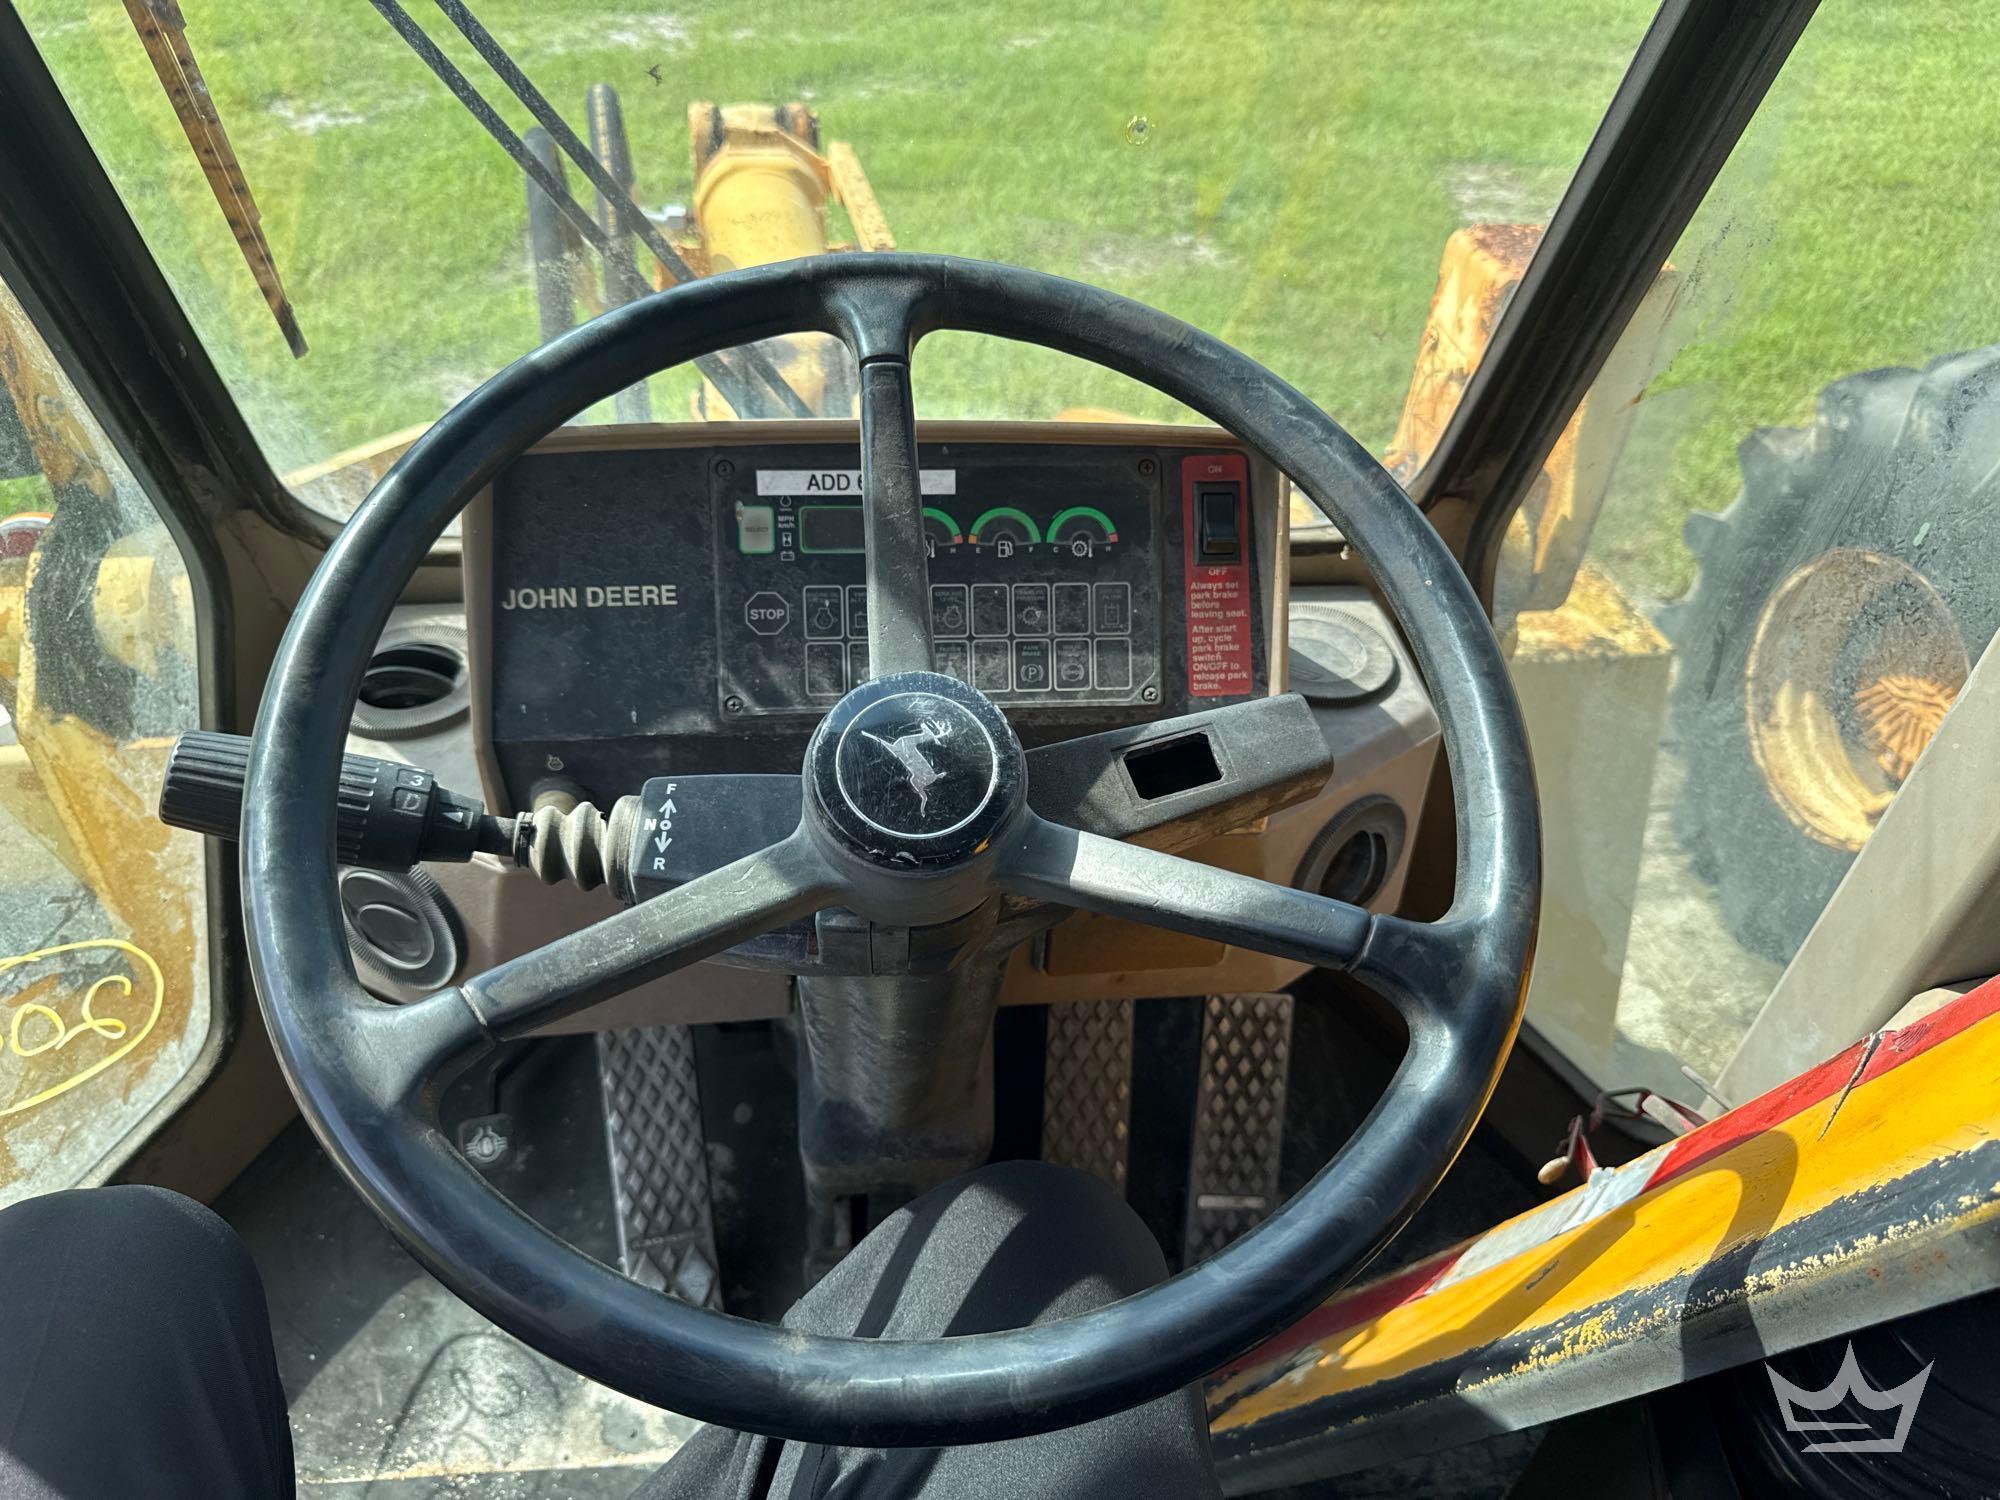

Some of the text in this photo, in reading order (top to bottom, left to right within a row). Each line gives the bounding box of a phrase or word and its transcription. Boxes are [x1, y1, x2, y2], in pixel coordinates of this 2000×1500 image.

[1208, 465, 1222, 474] ON
[807, 473, 850, 491] ADD
[1208, 567, 1228, 576] OFF
[1191, 581, 1239, 590] Always set
[502, 585, 678, 610] JOHN DEERE
[1191, 590, 1239, 601] park brake
[1191, 600, 1220, 609] before
[750, 608, 785, 620] STOP
[1191, 609, 1247, 620] leaving seat.
[1192, 625, 1237, 633] After start
[1208, 634, 1232, 645] cycle
[1192, 643, 1240, 653] park brake
[1192, 652, 1222, 662] switch
[1193, 662, 1240, 671] ON/OFF to
[1193, 671, 1248, 681] release park
[1193, 682, 1221, 691] brake.
[410, 775, 425, 786] 3
[666, 783, 678, 795] F
[643, 818, 657, 831] N
[653, 857, 666, 870] R
